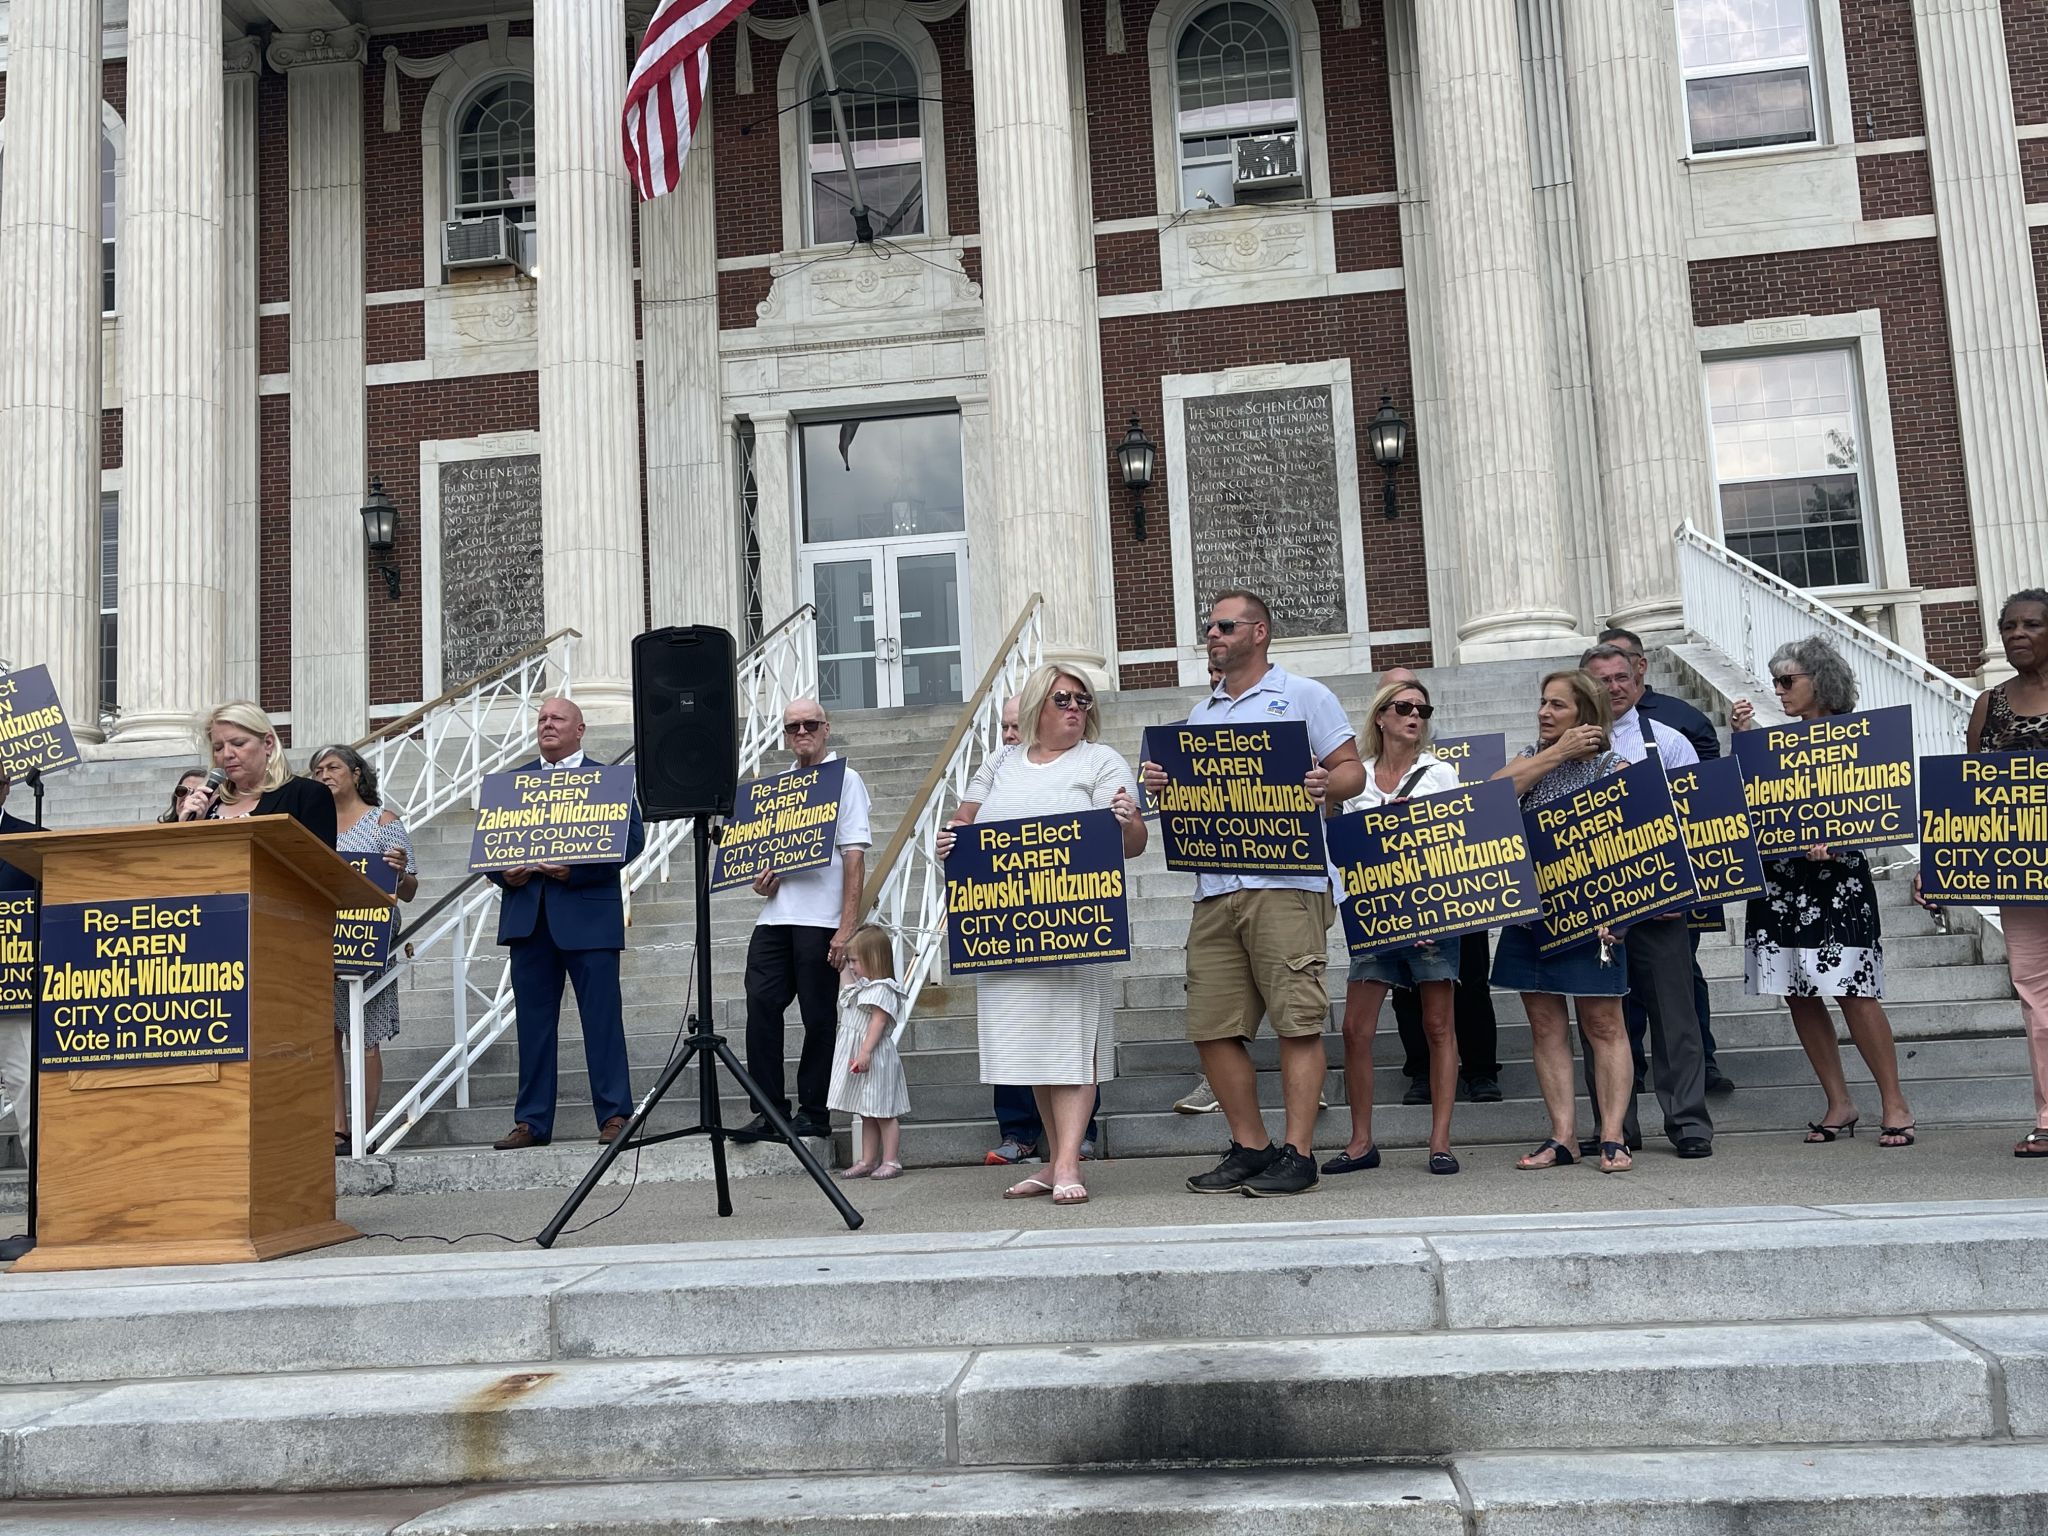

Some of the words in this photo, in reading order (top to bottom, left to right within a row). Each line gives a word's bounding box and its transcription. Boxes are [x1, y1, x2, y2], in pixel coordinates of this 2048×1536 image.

[1245, 394, 1328, 414] SCHENECTADY
[1288, 411, 1328, 422] INDIANS
[1204, 432, 1224, 442] VAN
[1308, 423, 1328, 432] AND
[1196, 529, 1240, 540] WESTERN
[1245, 524, 1296, 536] TERMINUS
[1300, 522, 1311, 532] OF
[1316, 520, 1335, 530] THE
[1196, 541, 1238, 552] MOHAWK
[0, 732, 60, 759] UNCIL
[1179, 729, 1272, 753] Re-Elect
[1769, 718, 1870, 750] Re-Elect
[2, 753, 42, 776] Row
[47, 744, 64, 760] C
[1192, 757, 1263, 776] KAREN
[1780, 743, 1858, 770] KAREN
[1962, 756, 2048, 782] Re-Ele
[515, 771, 602, 789] Re-Elect
[750, 770, 819, 800] Re-Elect
[1744, 760, 1912, 806] alewski-Wildzunas
[522, 788, 589, 803] KAREN
[755, 790, 808, 815] KAREN
[1538, 778, 1629, 832] Re-Elect
[1798, 793, 1901, 820] COUNCIL
[1975, 786, 2048, 806] KARE
[477, 801, 627, 830] Zalewski-Wildzunas
[719, 802, 838, 848] Zalewski-Wildzunas
[1172, 818, 1211, 835] CITY
[1216, 818, 1309, 836] COUNCIL
[1365, 794, 1475, 834] Re-Elect
[1554, 806, 1624, 850] KAREN
[1801, 823, 1818, 841] in
[1826, 820, 1875, 838] Row
[1881, 812, 1899, 831] C
[1922, 806, 2048, 843] Zalewski-Wil
[485, 830, 528, 845] CITY
[530, 824, 615, 841] COUNCIL
[485, 846, 525, 860] Vote
[530, 843, 545, 856] in
[551, 841, 593, 854] Row
[597, 838, 612, 850] C
[724, 843, 757, 863] CITY
[759, 828, 826, 854] COUNCIL
[980, 820, 1081, 850] Re-Elect
[1175, 838, 1216, 857] Vote
[1220, 838, 1238, 857] in
[1242, 839, 1287, 859] Row
[1292, 840, 1309, 860] C
[1381, 820, 1466, 853] KAREN
[724, 861, 754, 878] Vote
[757, 856, 770, 871] in
[774, 849, 807, 866] Row
[811, 842, 823, 857] C
[993, 847, 1070, 872] KAREN
[1534, 813, 1678, 894] lewski-Wildzunas
[1935, 848, 1989, 866] CITY
[1584, 852, 1675, 898] COUNCIL
[1726, 866, 1744, 886] C
[1937, 870, 1990, 889] Vote
[1997, 869, 2017, 889] in
[949, 868, 1123, 913] Zalewski-Wildzunas
[1356, 891, 1405, 916] CITY
[1411, 869, 1520, 905] COUNCIL
[1545, 911, 1588, 936] Vote
[1590, 901, 1609, 920] in
[1611, 882, 1655, 912] Row
[1660, 871, 1678, 891] C
[85, 904, 201, 933] Re-Elect
[961, 914, 1008, 935] CITY
[1012, 905, 1114, 930] COUNCIL
[1360, 915, 1412, 937] Vote
[1417, 907, 1438, 926] in
[1443, 897, 1495, 920] Row
[1502, 888, 1521, 907] C
[97, 934, 186, 958] KAREN
[361, 942, 376, 958] C
[964, 937, 1010, 957] Vote
[1016, 933, 1034, 953] in
[1040, 931, 1088, 951] Row
[1095, 926, 1112, 945] C
[42, 956, 244, 1001] Zalewski-Wildzunas
[54, 1005, 109, 1027] CITY
[114, 998, 232, 1023] COUNCIL
[56, 1030, 110, 1051] Vote
[117, 1026, 137, 1048] in
[145, 1025, 201, 1047] Row
[208, 1021, 228, 1043] C
